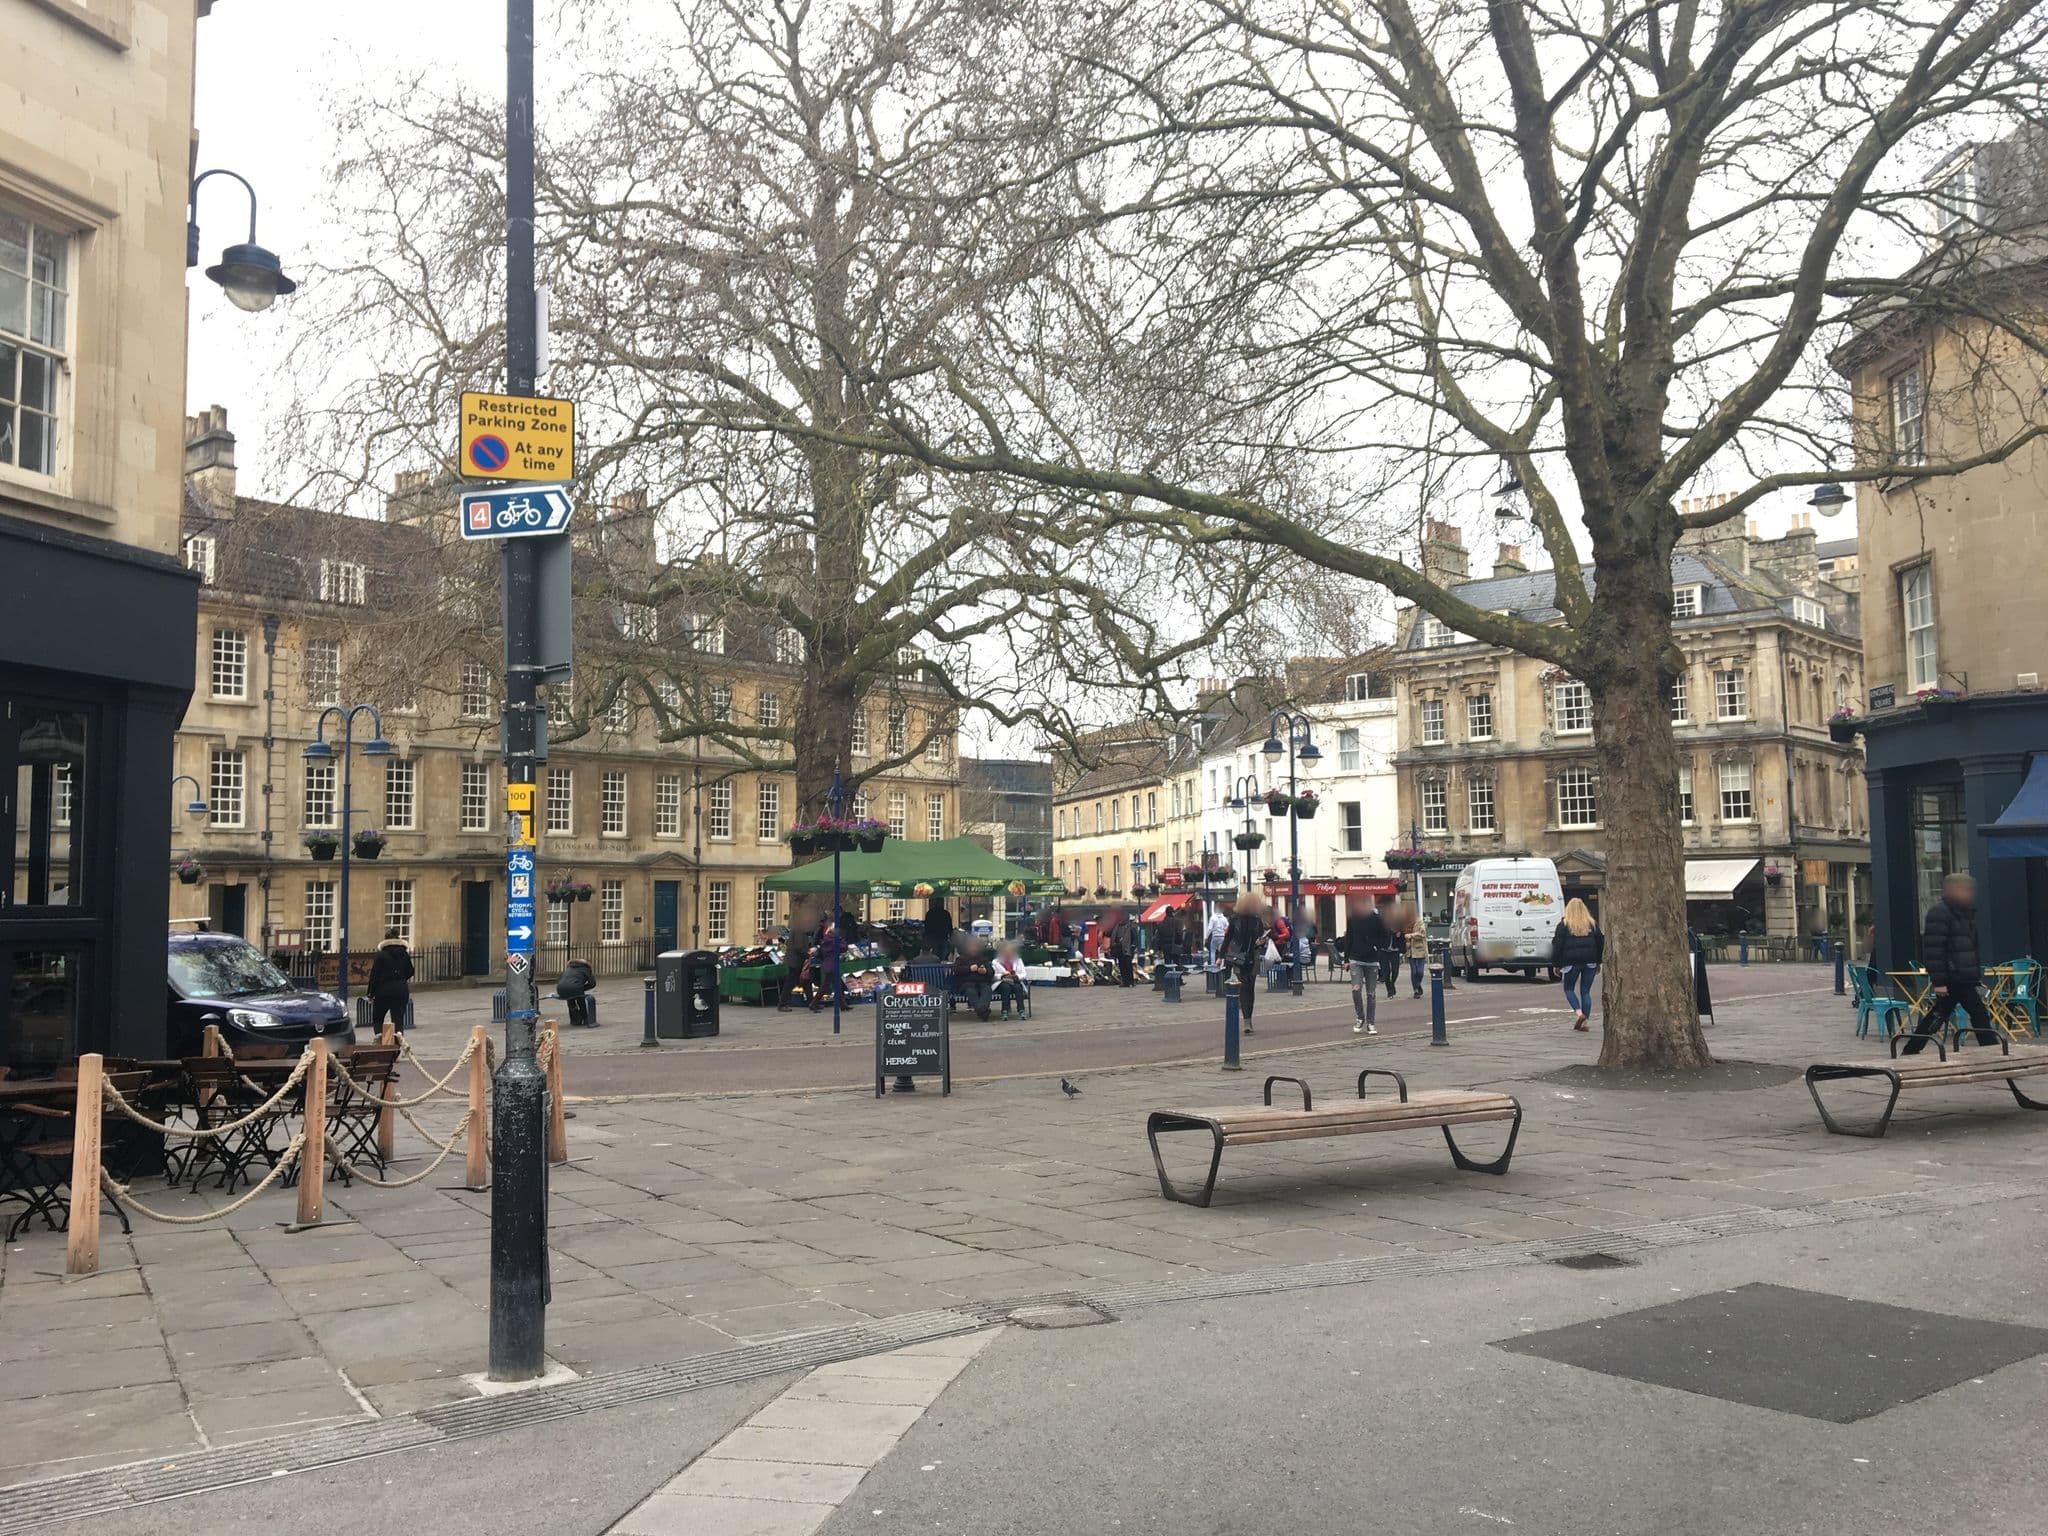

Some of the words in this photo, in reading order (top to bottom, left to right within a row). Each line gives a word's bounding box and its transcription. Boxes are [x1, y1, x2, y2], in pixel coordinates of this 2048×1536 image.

[479, 399, 557, 417] Restricted
[468, 413, 525, 431] Parking
[531, 418, 567, 432] Zone
[515, 442, 532, 454] At
[538, 446, 564, 458] any
[523, 457, 555, 470] time
[473, 507, 487, 524] 4
[510, 792, 527, 801] 100
[897, 985, 924, 994] SALE
